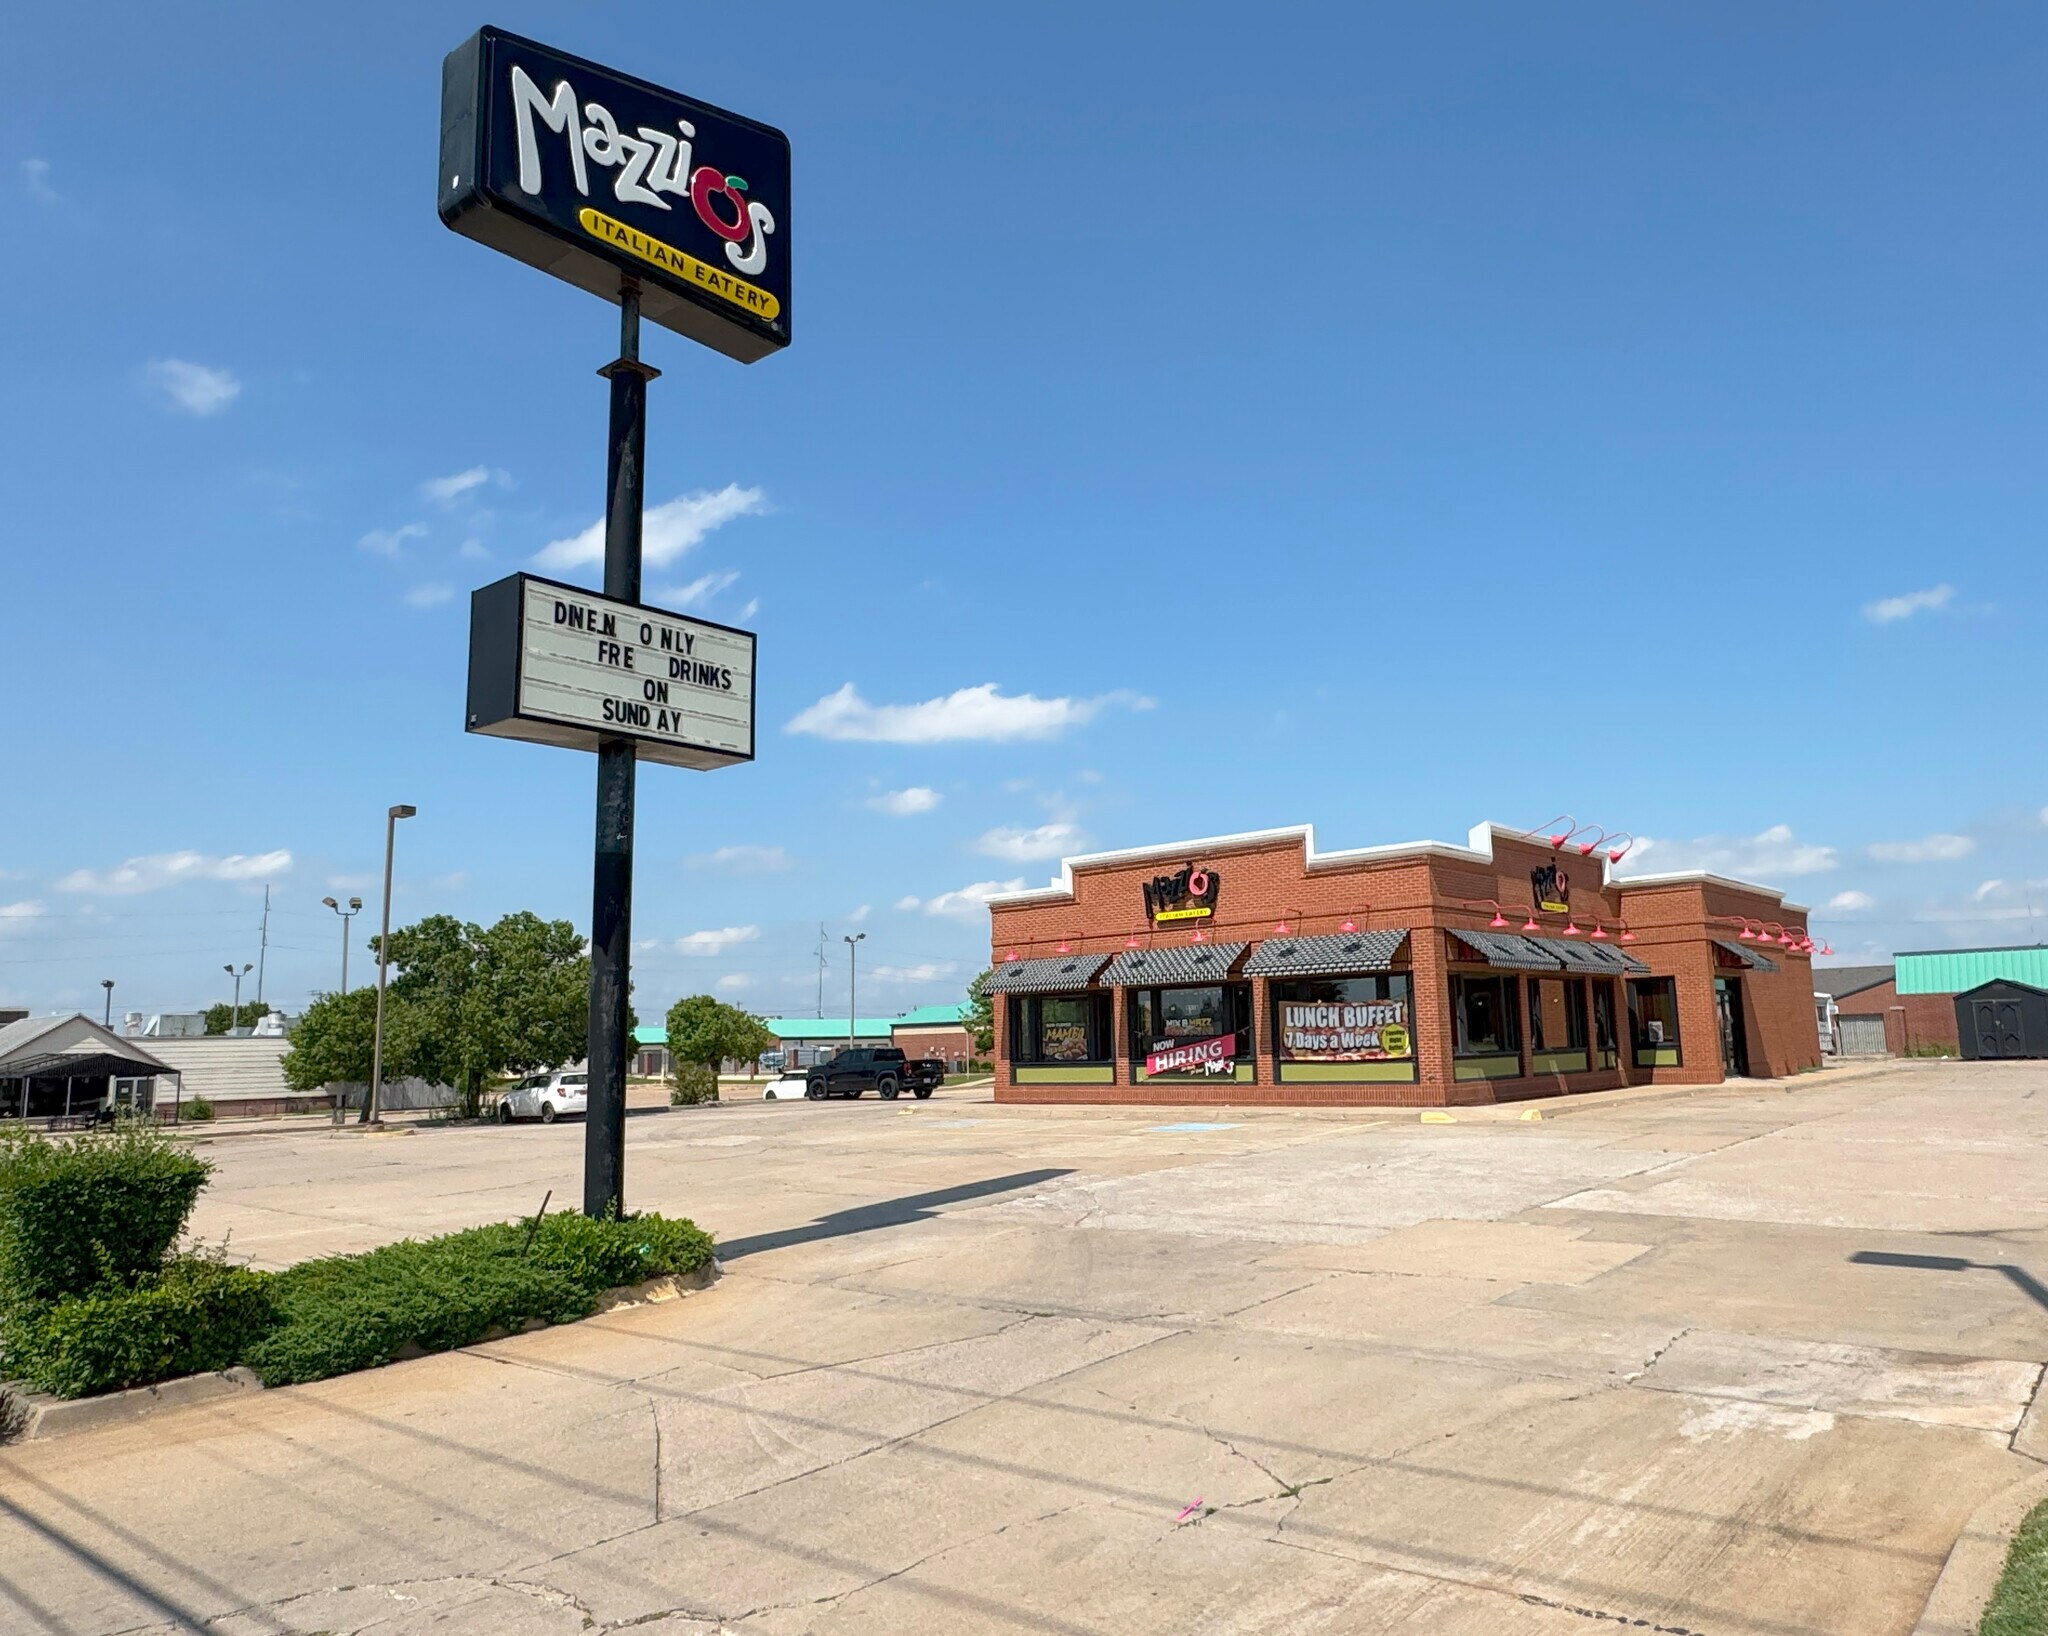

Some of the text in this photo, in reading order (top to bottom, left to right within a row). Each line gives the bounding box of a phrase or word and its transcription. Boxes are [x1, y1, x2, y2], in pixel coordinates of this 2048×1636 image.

[593, 214, 770, 312] ITALIAN EATERY
[597, 639, 733, 691] FRE DRINKS
[643, 678, 669, 704] ON
[1284, 1002, 1404, 1028] LUNCH BUFFET
[1153, 1038, 1176, 1053] NOW
[1286, 1030, 1380, 1050] 7 Days a Week
[1155, 1040, 1223, 1073] HIRING
